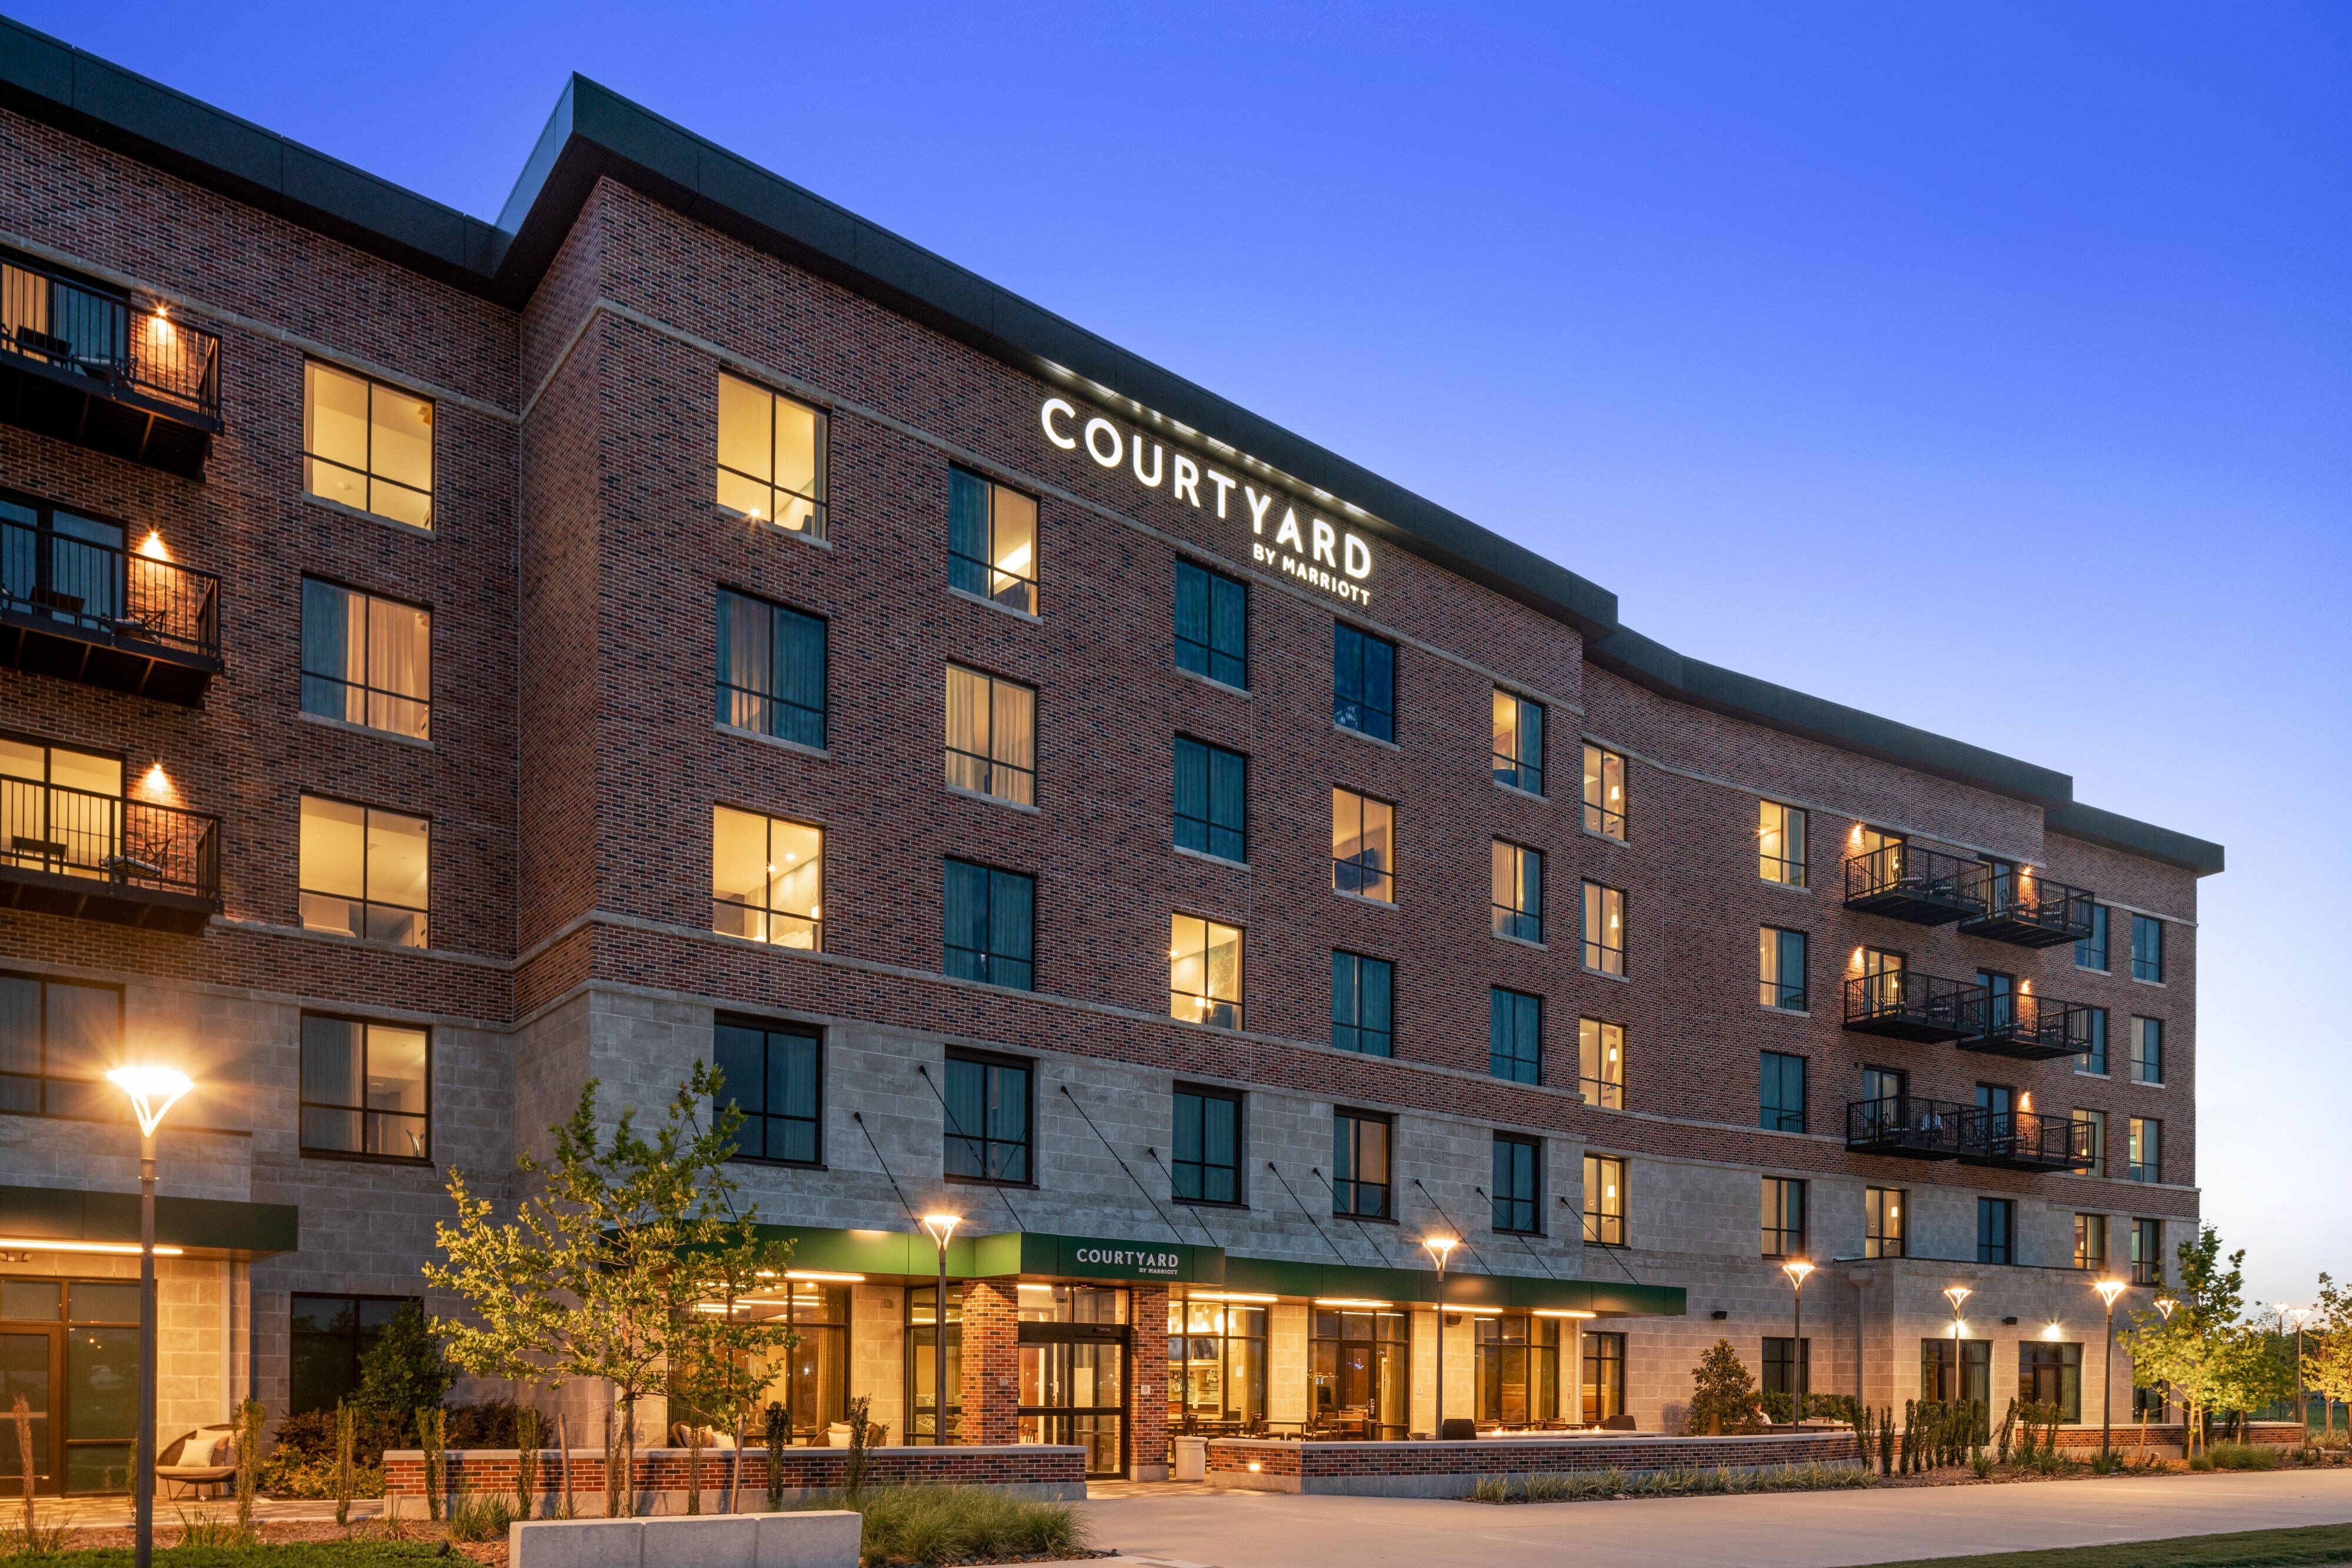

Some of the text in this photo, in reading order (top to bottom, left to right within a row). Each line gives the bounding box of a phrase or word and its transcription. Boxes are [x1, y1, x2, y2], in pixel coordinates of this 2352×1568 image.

[1041, 397, 1371, 579] COURTYARD
[1252, 542, 1371, 606] BY MARRIOTT
[1076, 1248, 1178, 1268] COURTYARD
